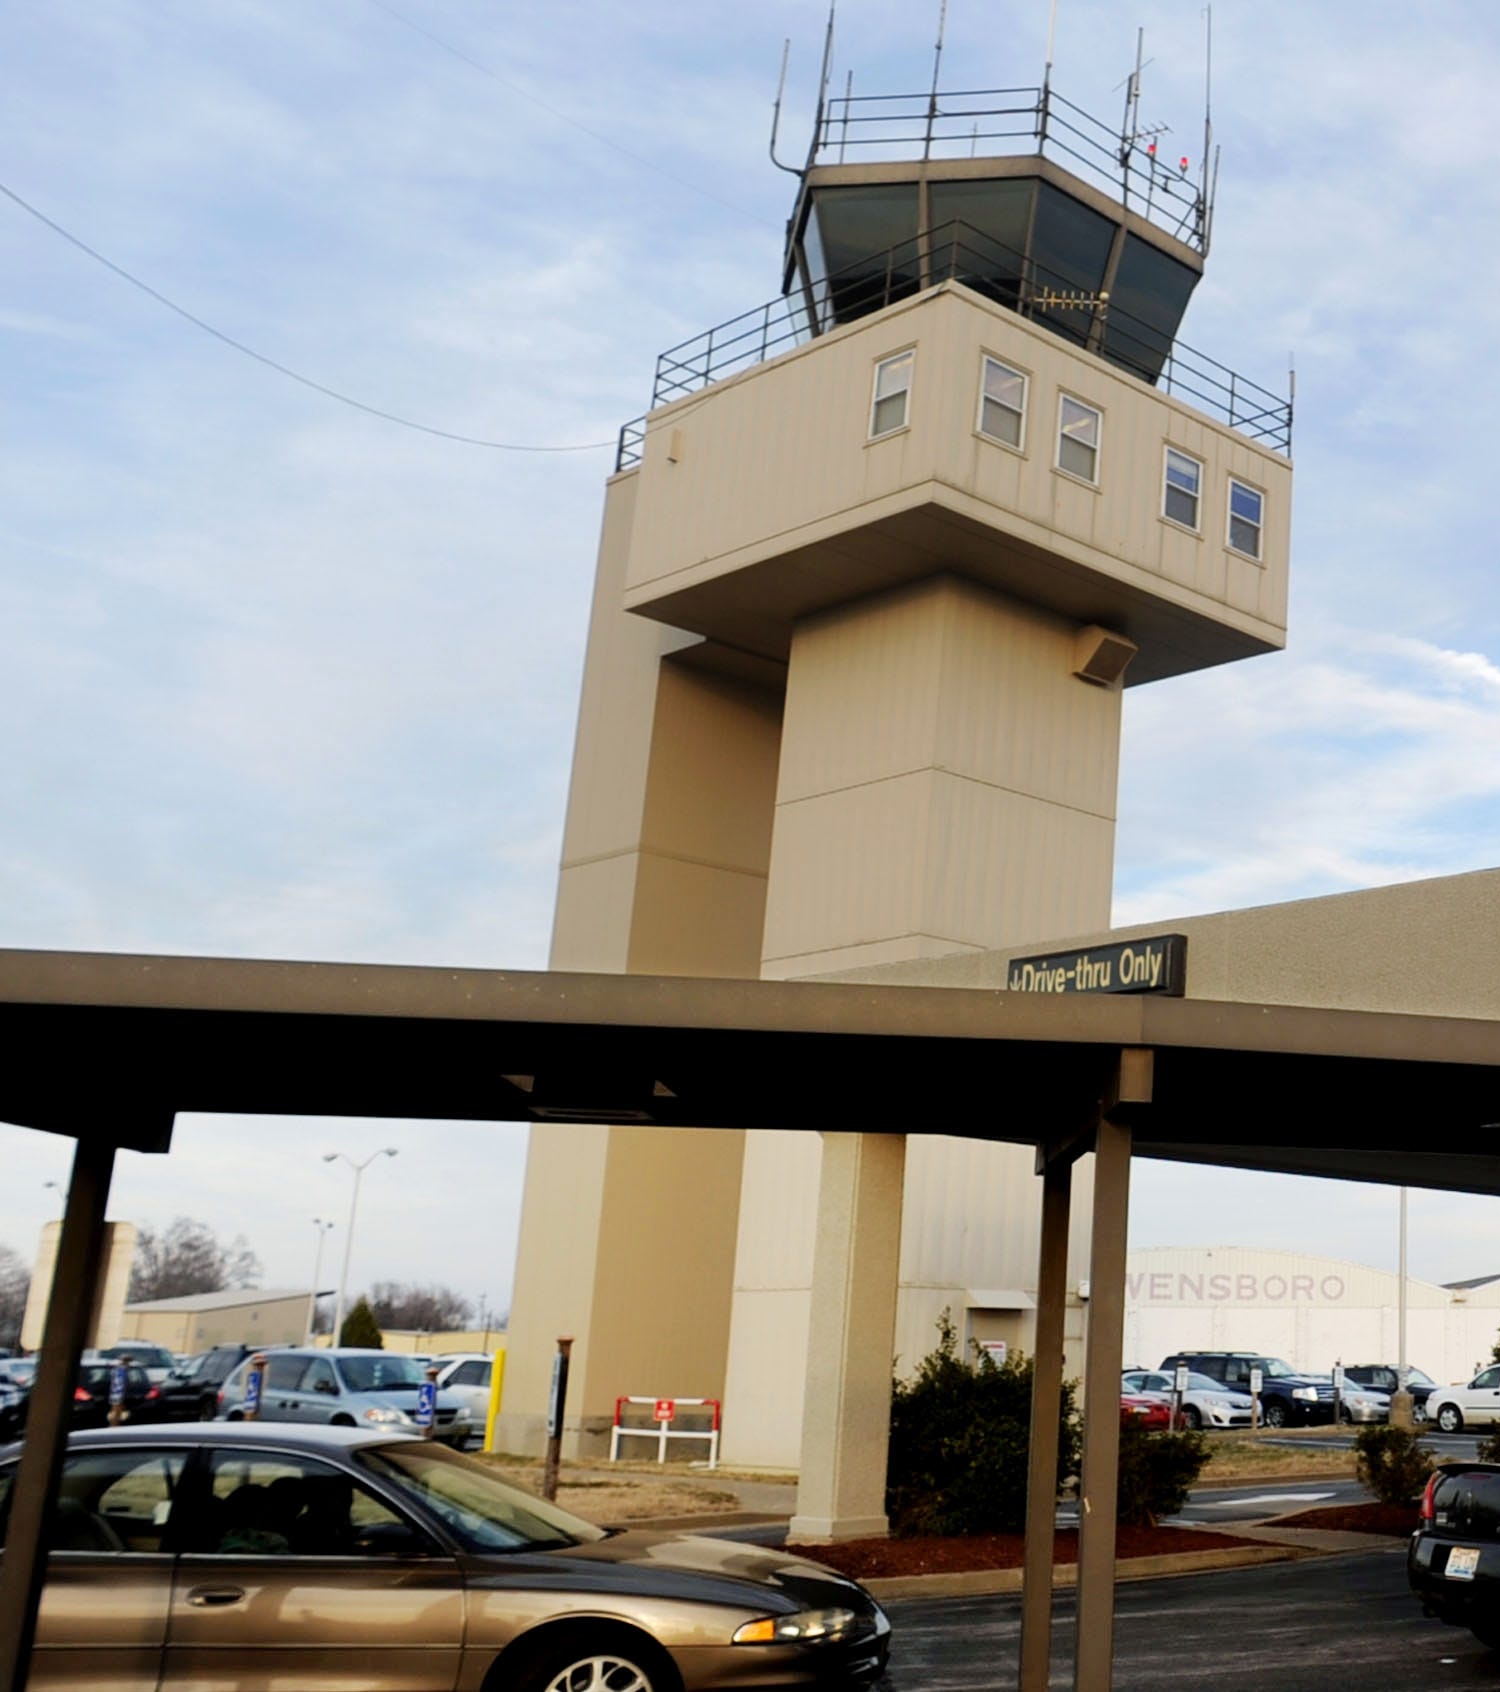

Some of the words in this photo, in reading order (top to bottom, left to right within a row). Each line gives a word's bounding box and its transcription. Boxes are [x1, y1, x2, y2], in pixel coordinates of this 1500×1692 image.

[1021, 955, 1112, 993] Drive-thru
[1119, 945, 1163, 988] Only
[1126, 1273, 1346, 1301] WENSBORO
